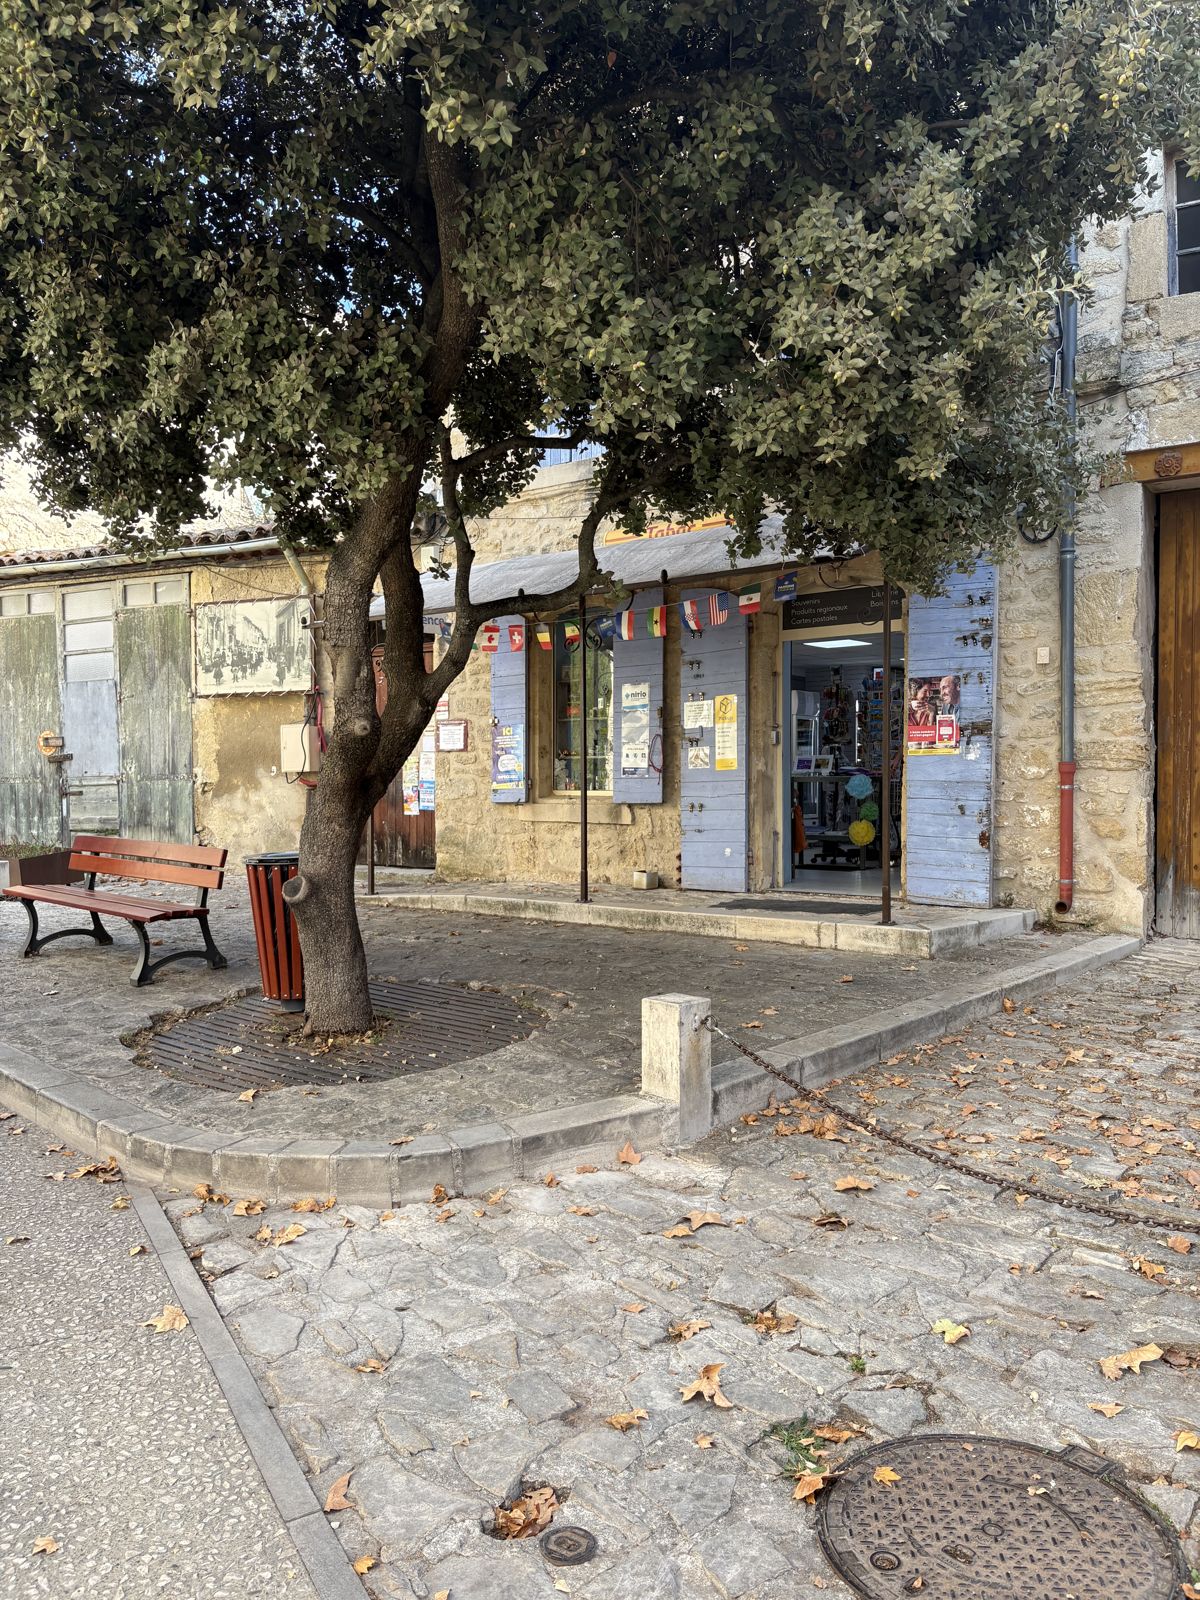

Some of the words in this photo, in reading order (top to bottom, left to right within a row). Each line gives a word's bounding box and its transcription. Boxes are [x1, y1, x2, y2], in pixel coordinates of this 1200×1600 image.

[791, 607, 816, 616] Produits
[790, 617, 812, 625] Cartes
[812, 614, 838, 625] postales
